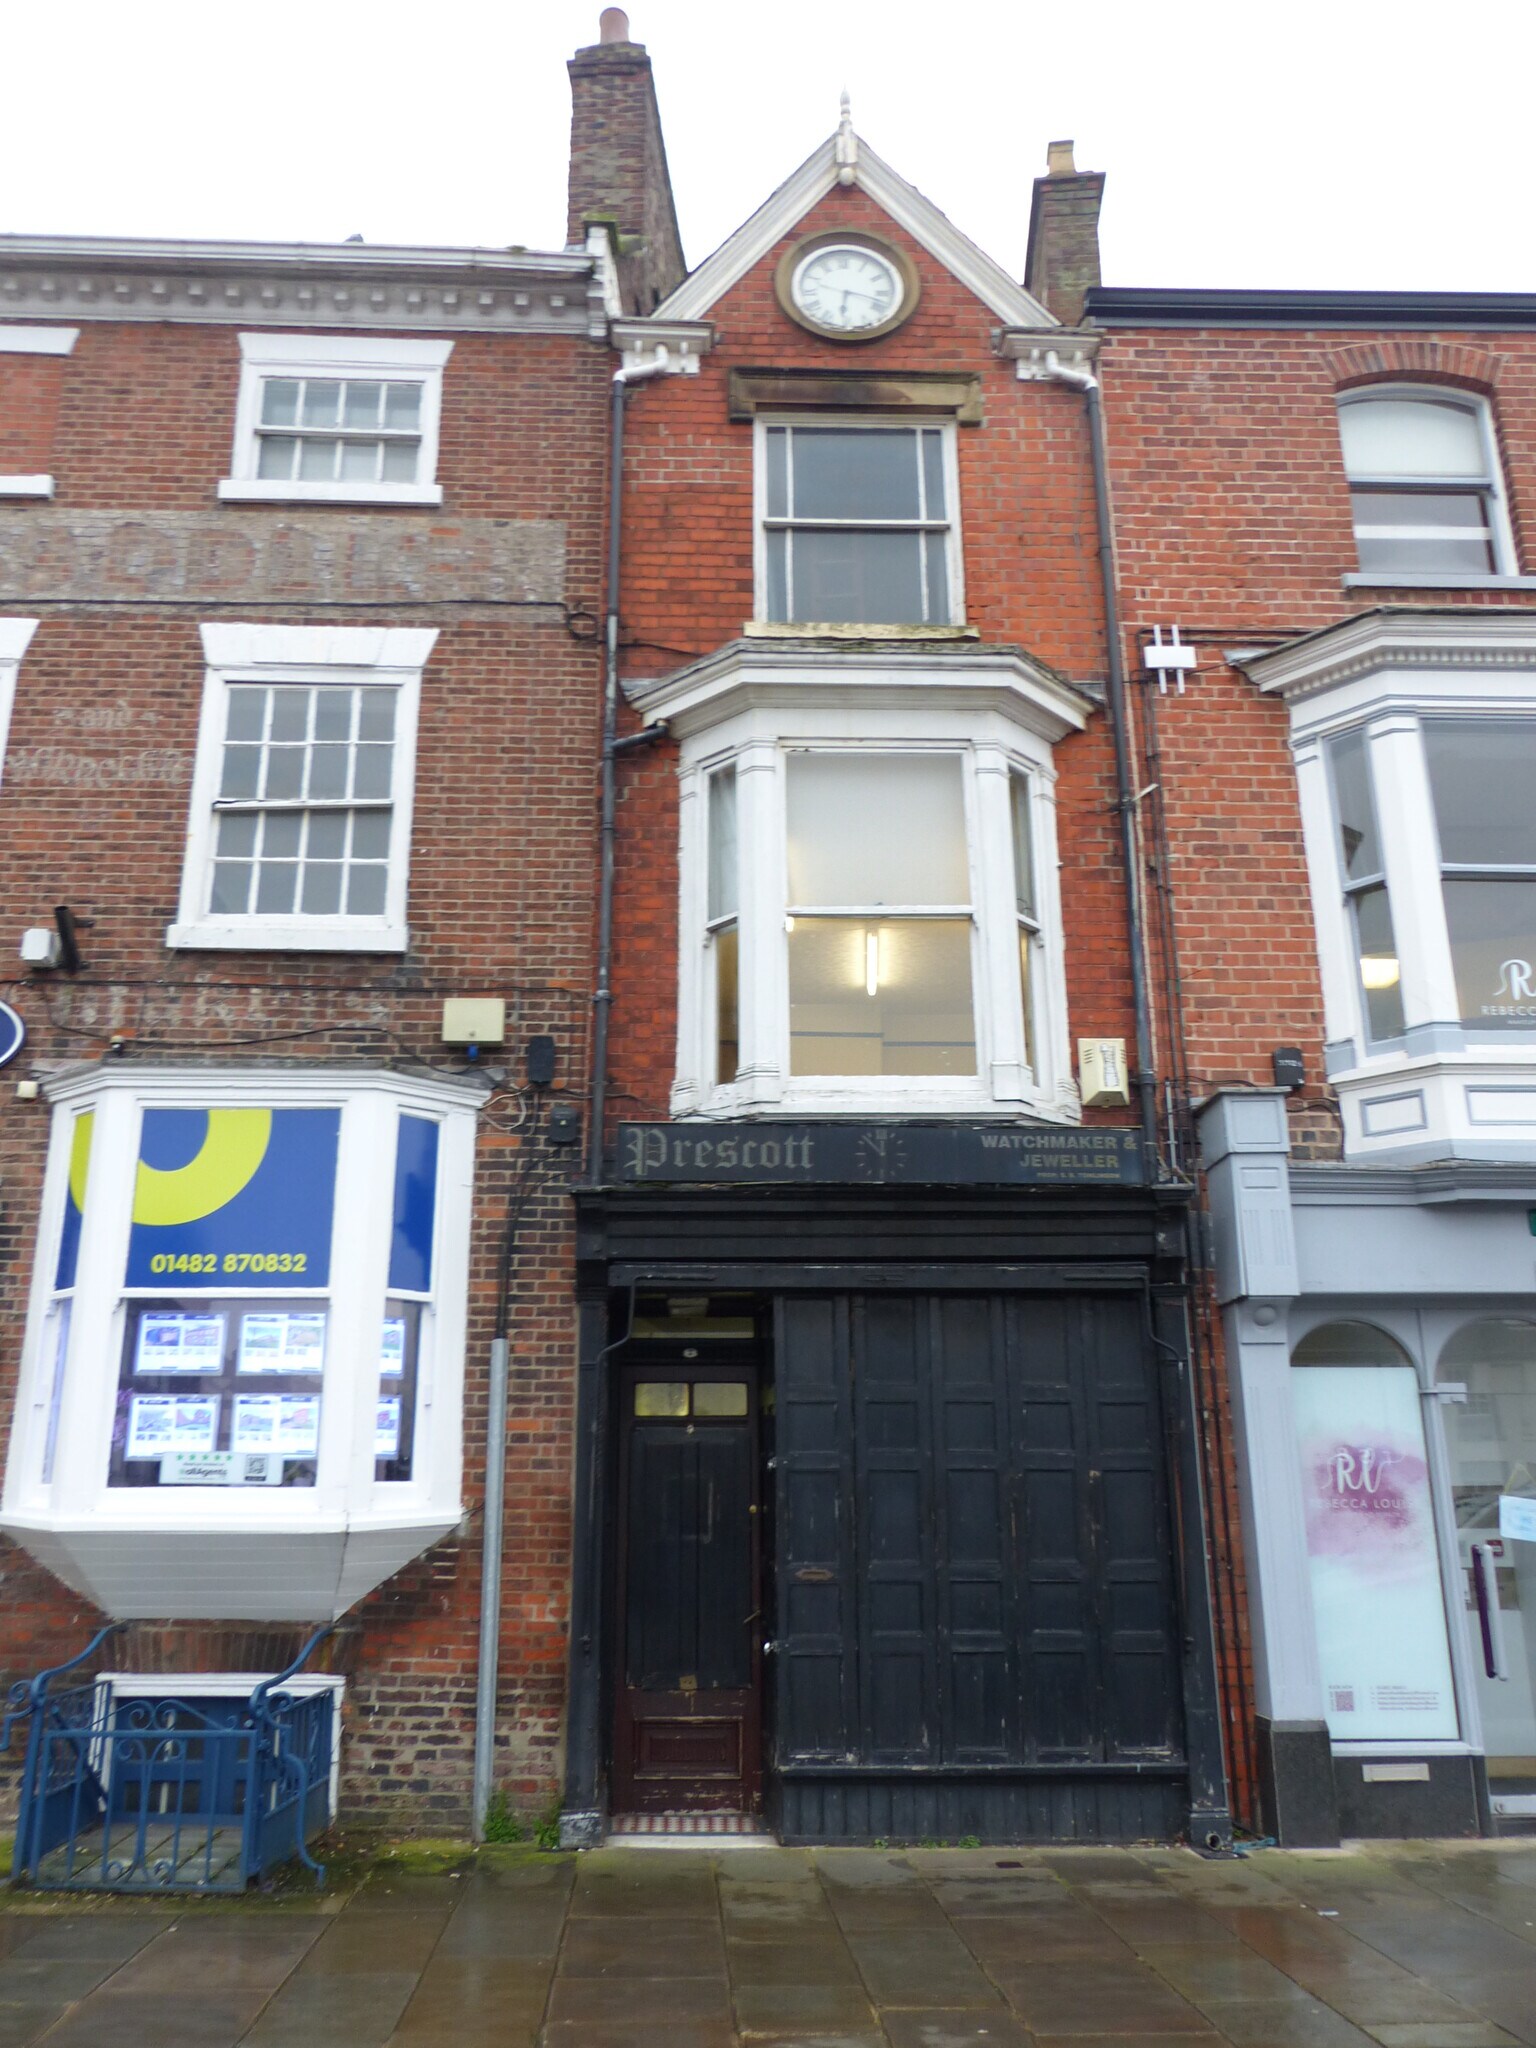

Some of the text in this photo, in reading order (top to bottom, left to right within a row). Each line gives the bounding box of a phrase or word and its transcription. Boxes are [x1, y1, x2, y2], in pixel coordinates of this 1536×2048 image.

[623, 1128, 815, 1176] Prescott
[981, 1135, 1138, 1151] WATCHMAKER &
[1019, 1154, 1119, 1168] JEWELLER
[150, 1253, 308, 1274] 01482 870832
